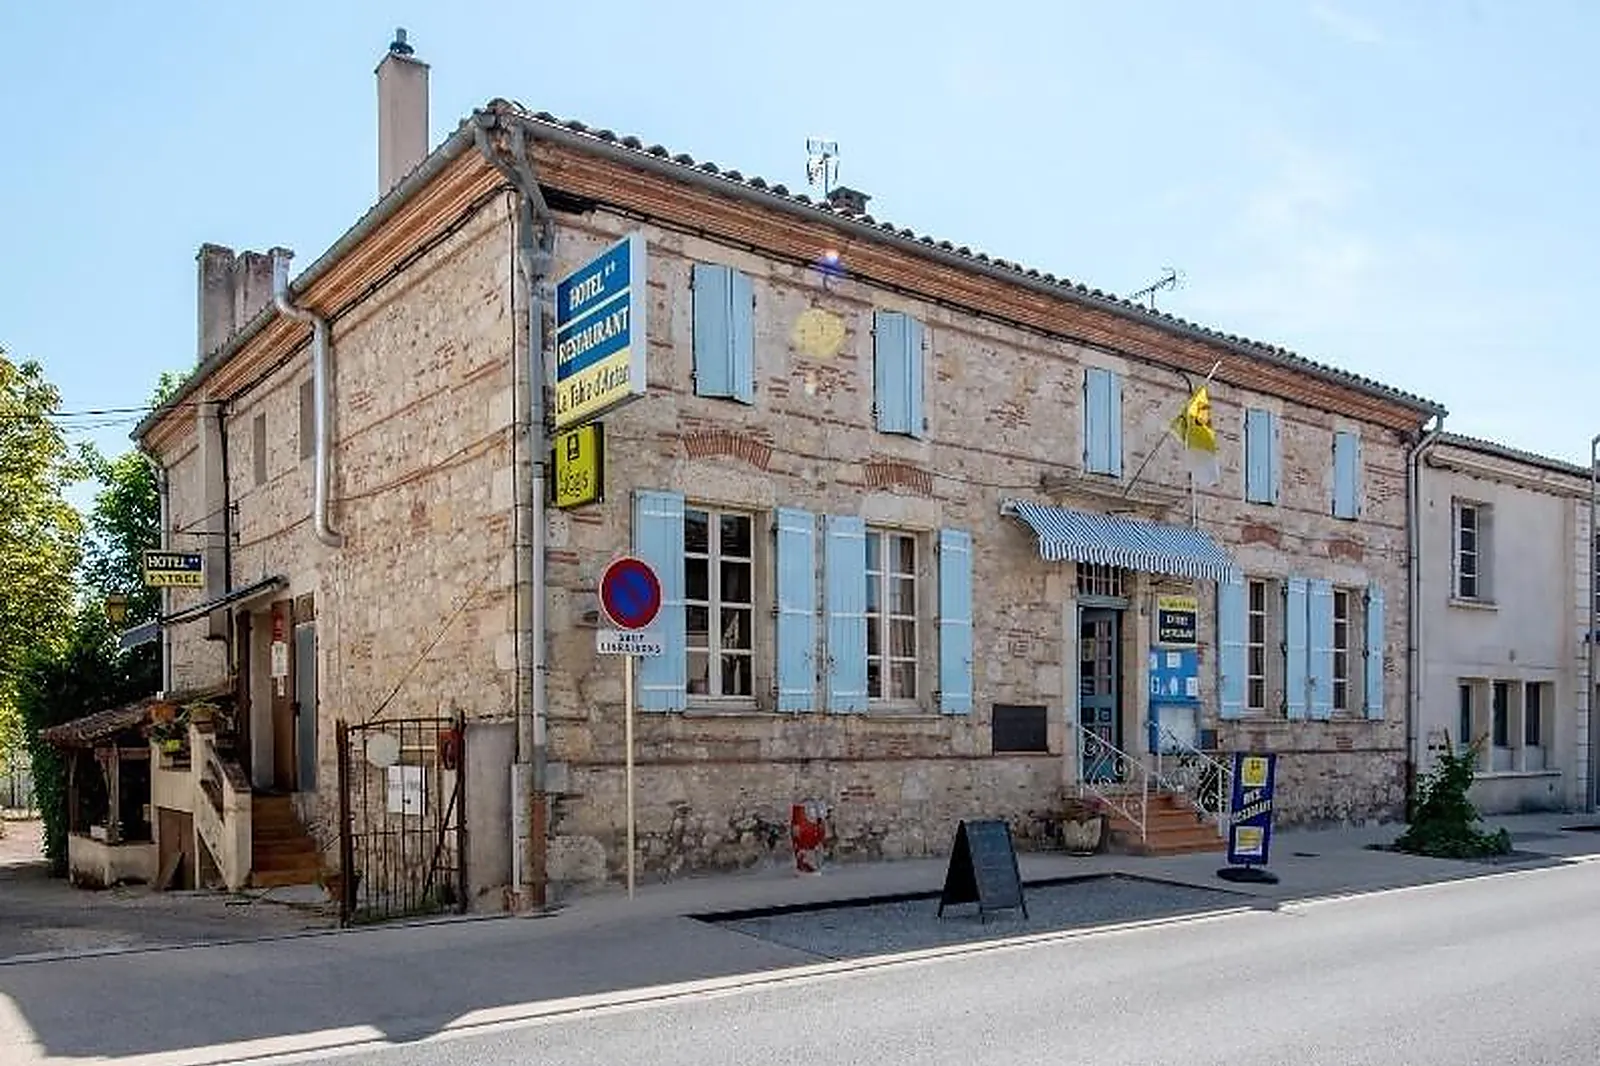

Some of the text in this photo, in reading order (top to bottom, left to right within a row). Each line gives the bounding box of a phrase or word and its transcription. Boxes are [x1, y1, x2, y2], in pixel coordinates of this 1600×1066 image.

[568, 270, 605, 312] HOTEL
[559, 305, 629, 368] RESTAURANT
[148, 555, 190, 568] HOTEL
